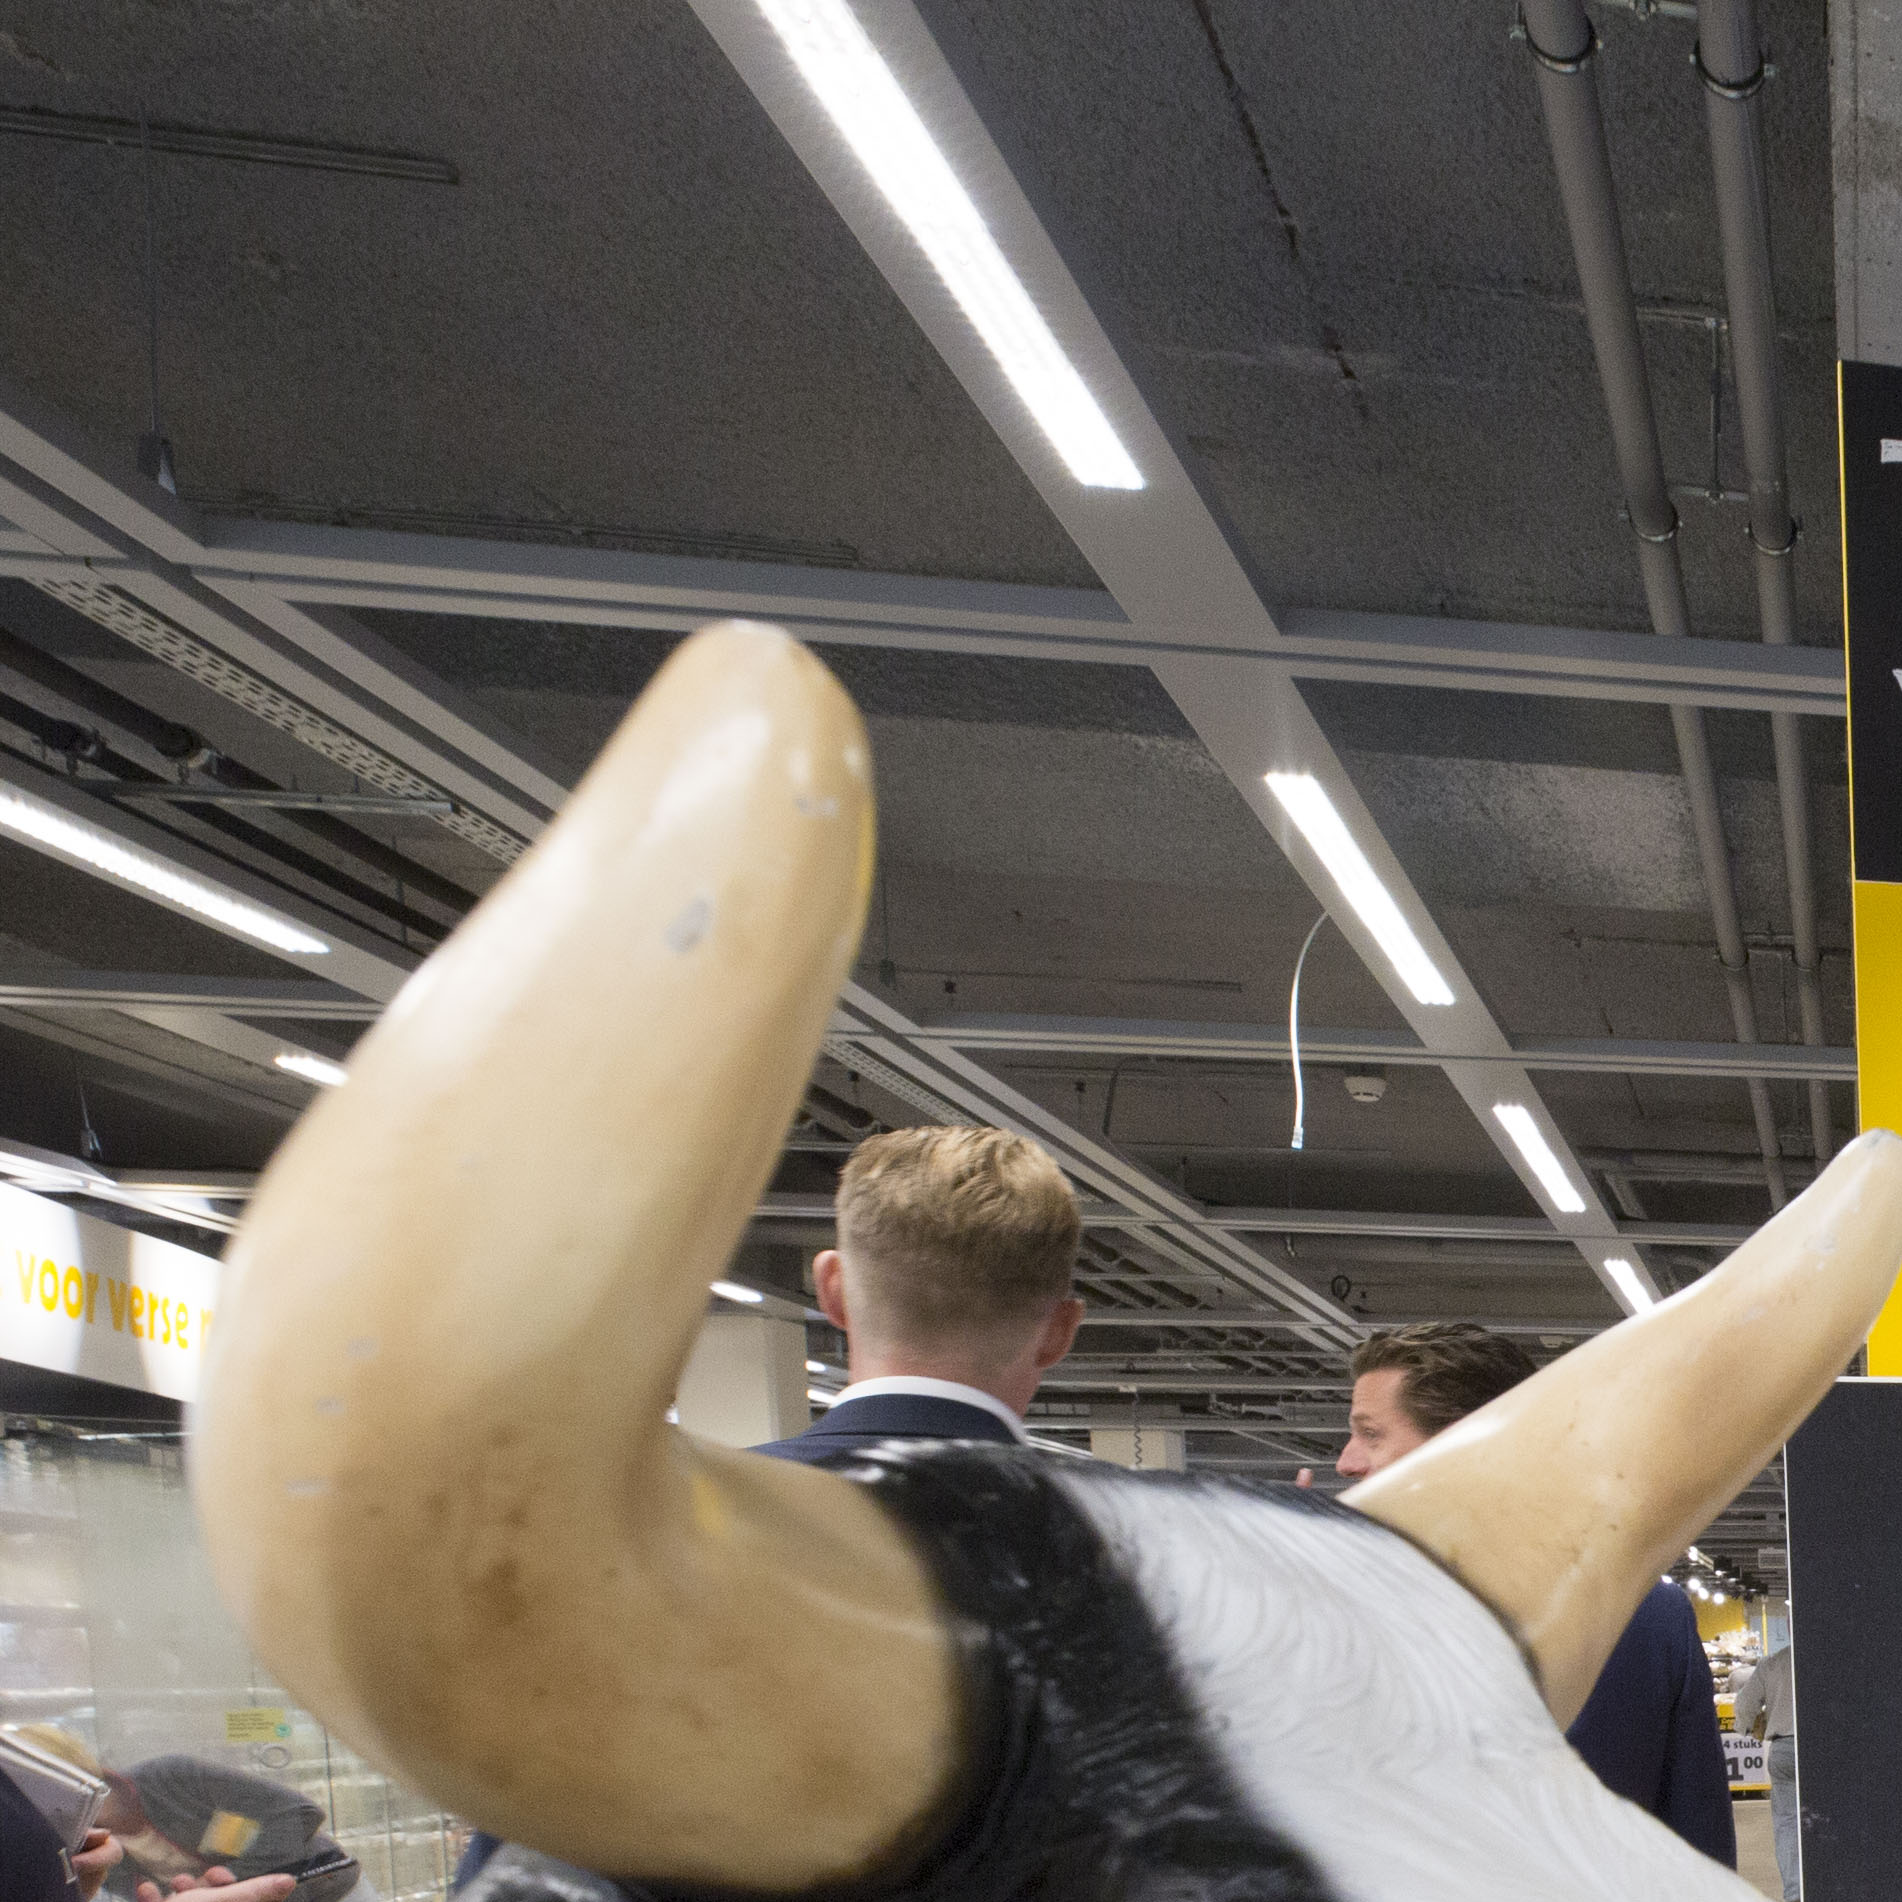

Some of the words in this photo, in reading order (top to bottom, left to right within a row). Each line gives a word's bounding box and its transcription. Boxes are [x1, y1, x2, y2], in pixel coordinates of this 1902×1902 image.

[15, 1249, 99, 1325] voor
[107, 1275, 190, 1350] verse
[1733, 1738, 1763, 1749] stuks
